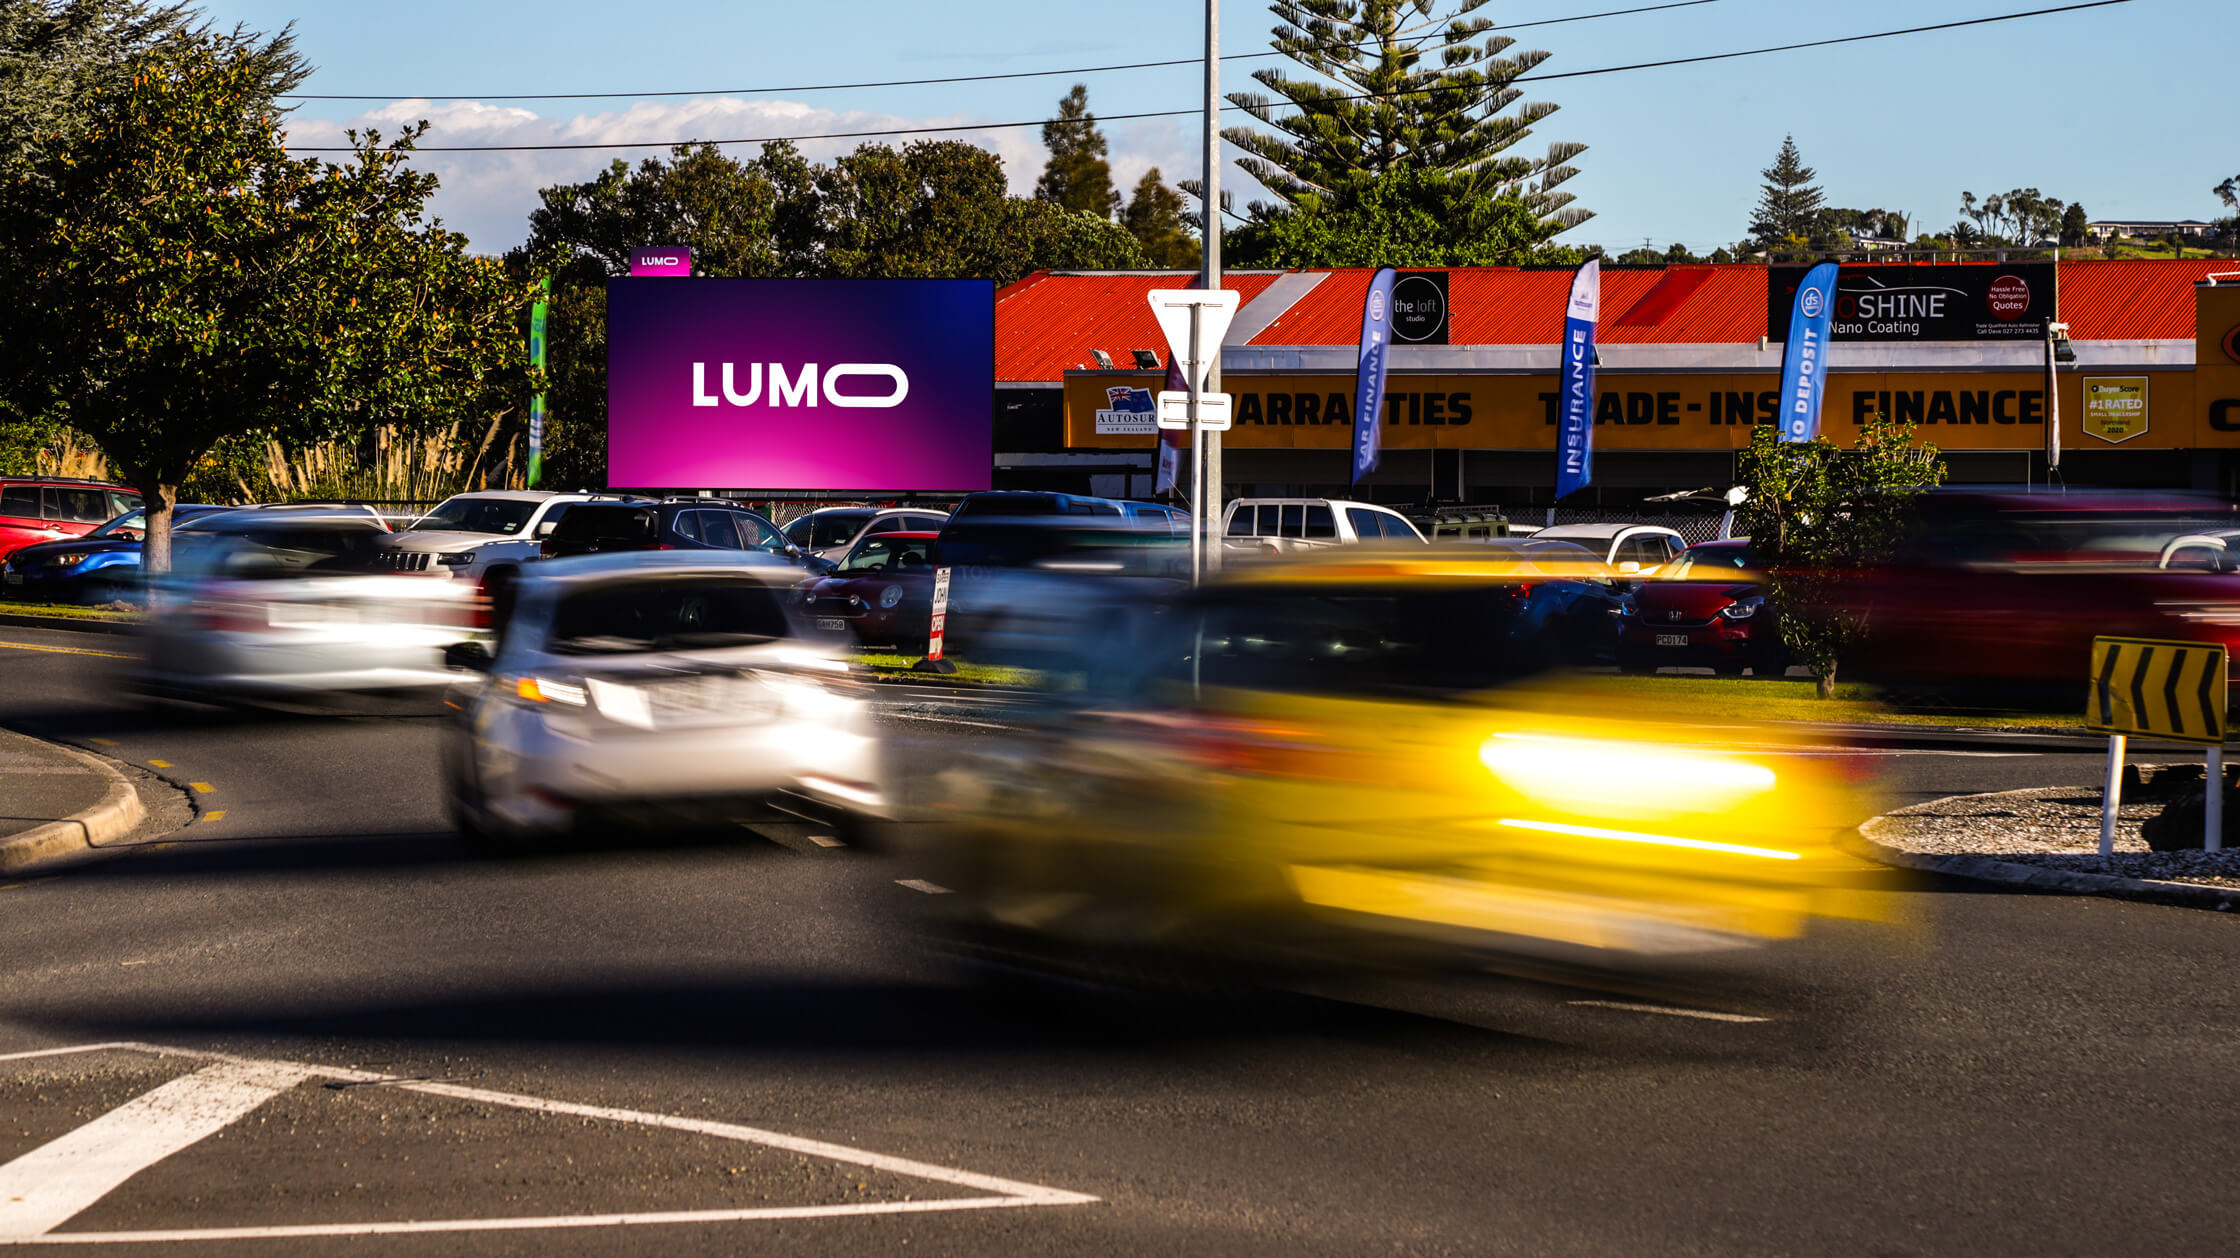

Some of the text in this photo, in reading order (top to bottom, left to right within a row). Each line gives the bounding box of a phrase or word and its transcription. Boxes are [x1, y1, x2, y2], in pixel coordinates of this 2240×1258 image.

[641, 256, 679, 266] LUMO
[1395, 299, 1414, 313] the
[1417, 299, 1437, 313] loft
[1832, 294, 1946, 319] OSHINE
[1993, 301, 2023, 311] Quotes
[1828, 320, 1920, 336] Nano Coating
[693, 362, 909, 408] LUMO
[1363, 330, 1382, 423] FINANCE
[1795, 328, 1819, 413] DEPOSIT
[1097, 412, 1155, 423] AUTOSUR
[1231, 392, 1473, 426] ARRATIES
[1538, 391, 1779, 425] TADE-INS
[1567, 329, 1587, 474] INSURANCE
[1853, 391, 2044, 425] FINANCE
[1359, 430, 1370, 470] CAR
[932, 615, 945, 632] OPEN
